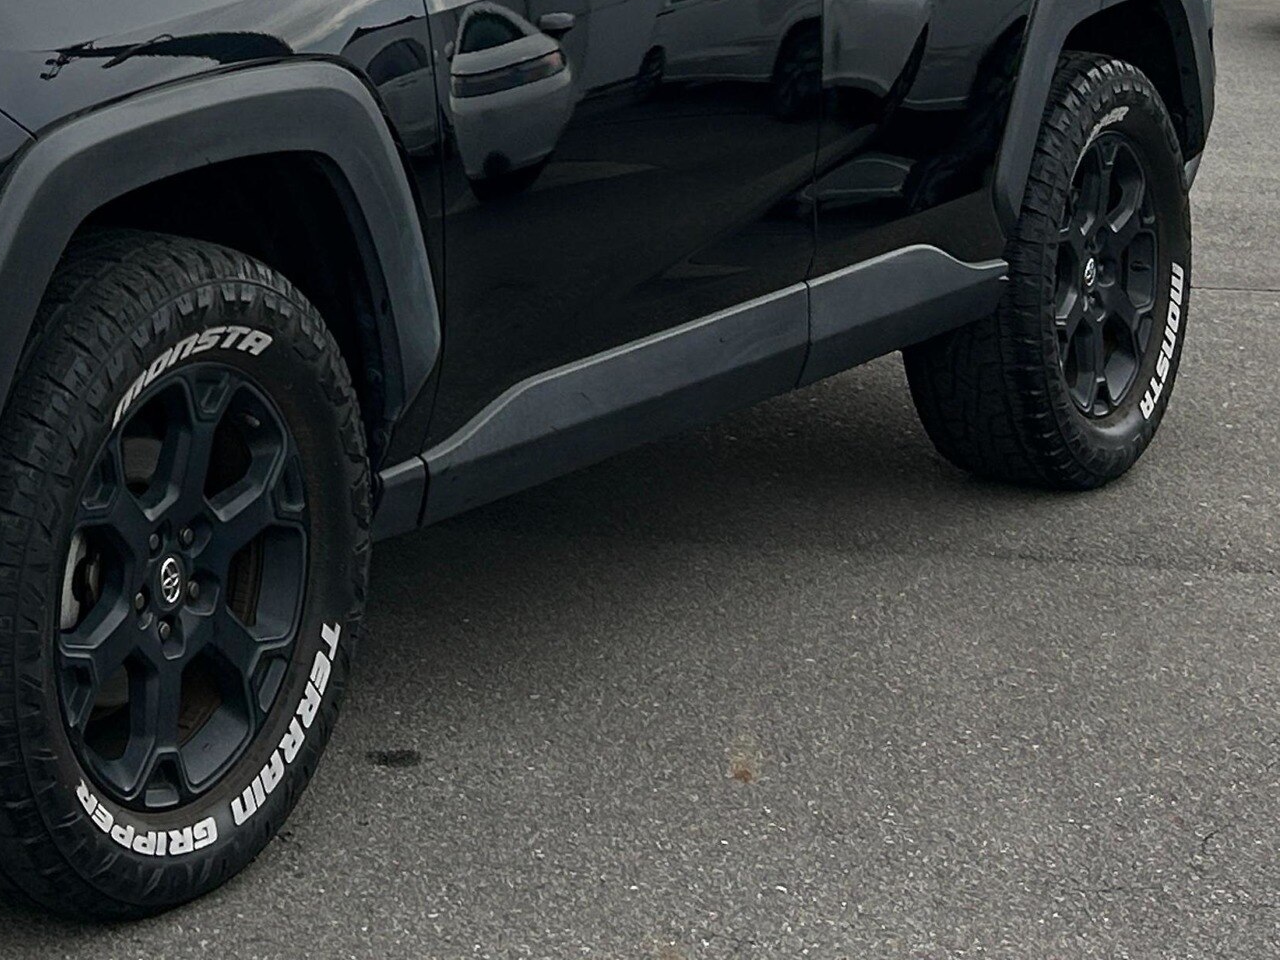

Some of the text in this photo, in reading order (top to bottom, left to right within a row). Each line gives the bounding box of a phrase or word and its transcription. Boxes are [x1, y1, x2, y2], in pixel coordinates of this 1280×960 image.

[112, 325, 274, 431] MONSTA
[1139, 261, 1184, 420] MONSTA
[76, 622, 341, 856] TERRAIN GRIPPER
